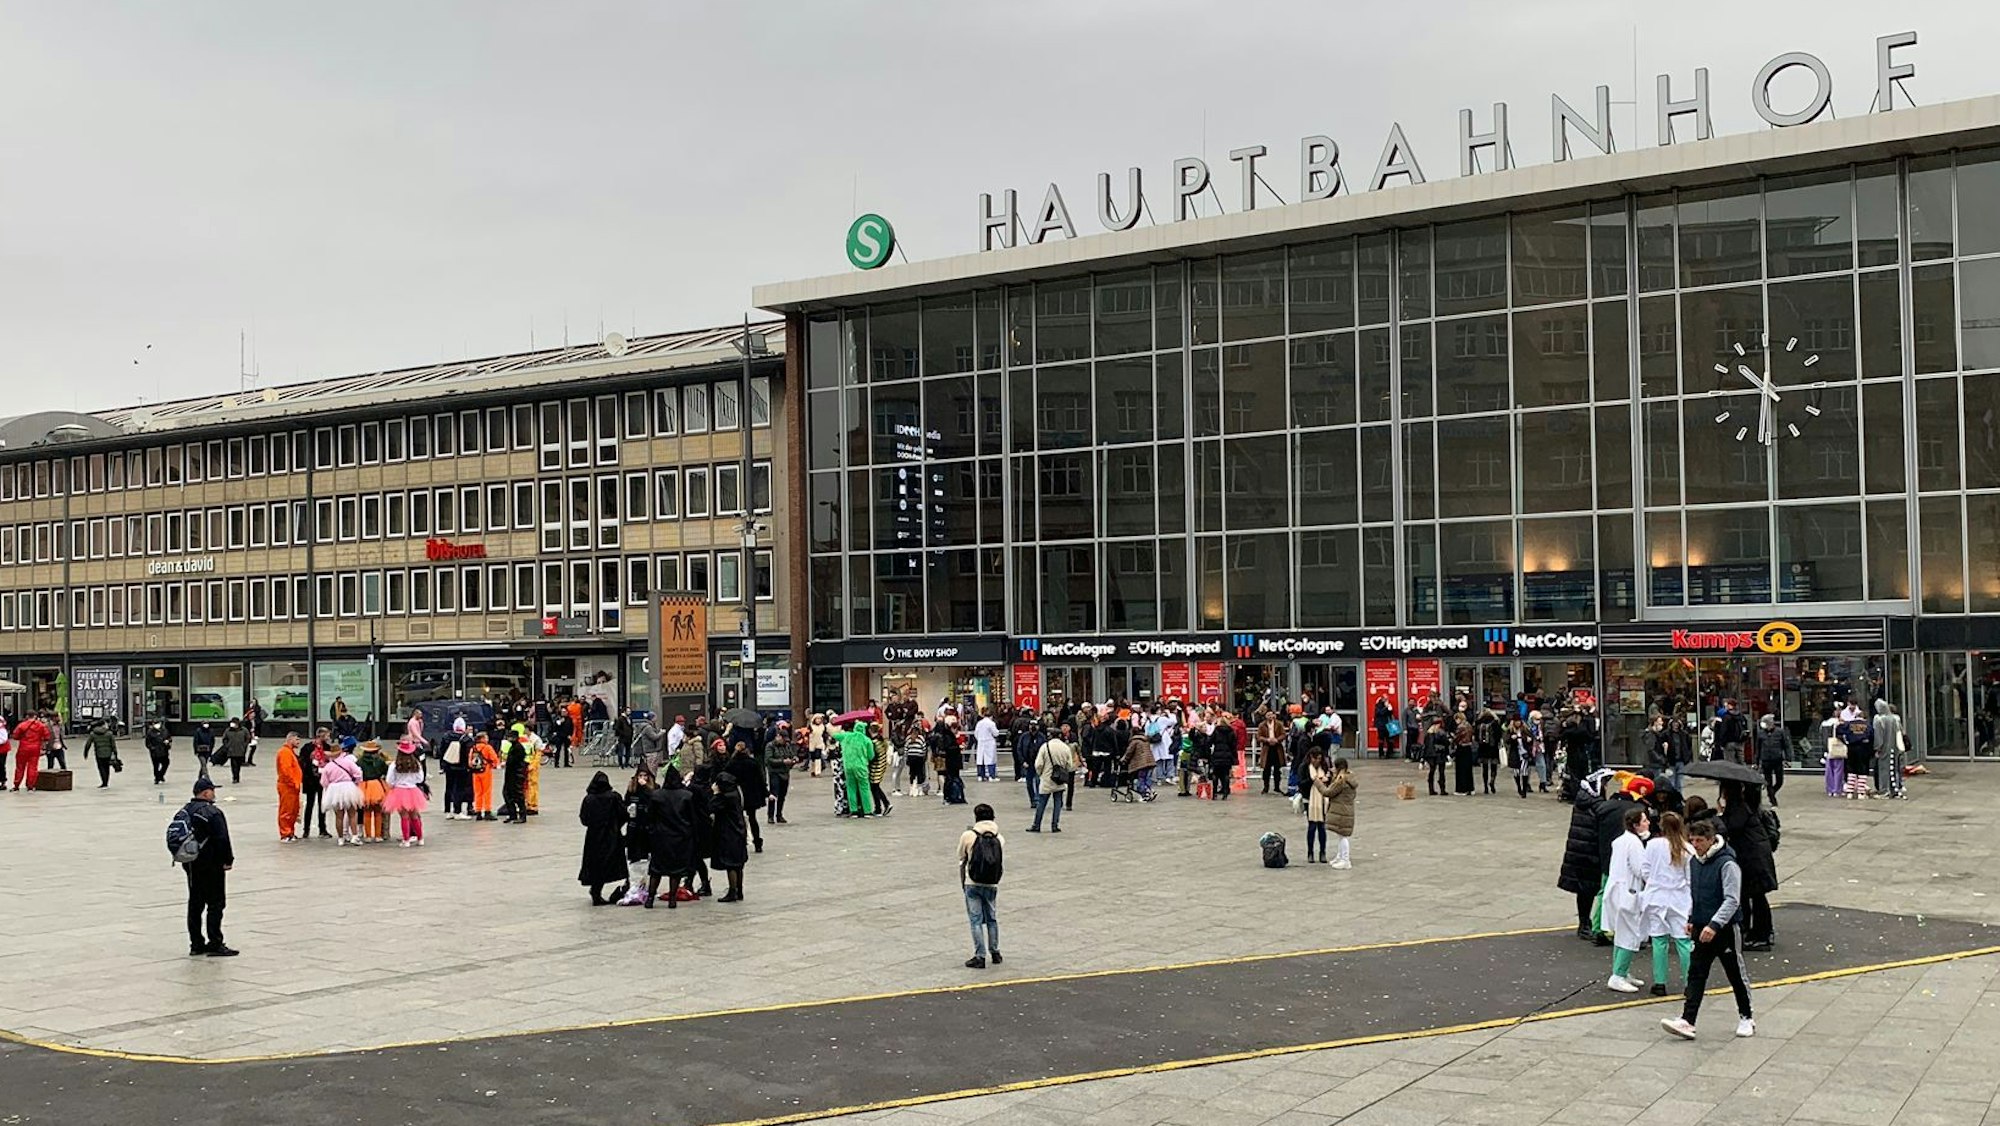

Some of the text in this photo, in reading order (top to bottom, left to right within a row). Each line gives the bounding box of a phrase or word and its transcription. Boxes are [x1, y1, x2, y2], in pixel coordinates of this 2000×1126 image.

[979, 31, 1918, 252] HAUPTBAHNHOF
[854, 221, 882, 263] S
[897, 646, 958, 657] THE BODY SHOP
[1041, 640, 1221, 660] NetCologne Highspeed
[1258, 635, 1468, 657] NetCologne Highspeed
[1671, 629, 1753, 652] Kamps
[78, 680, 118, 690] SALADS
